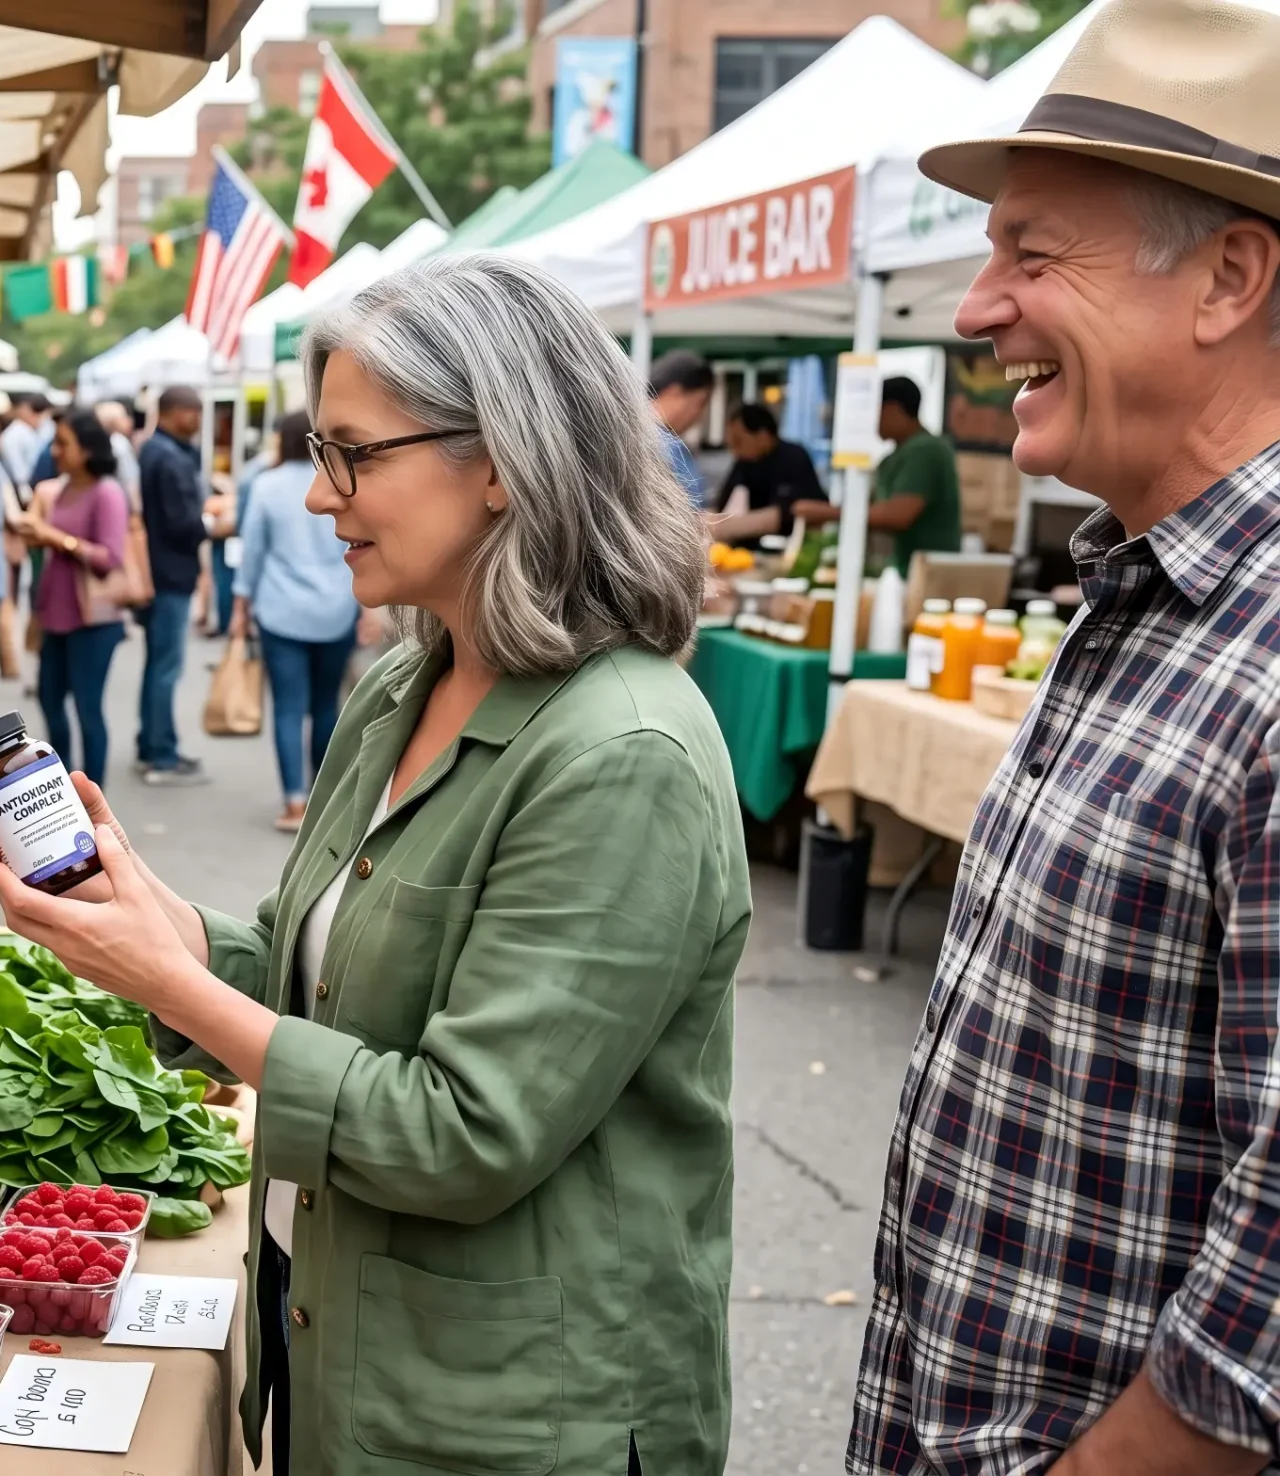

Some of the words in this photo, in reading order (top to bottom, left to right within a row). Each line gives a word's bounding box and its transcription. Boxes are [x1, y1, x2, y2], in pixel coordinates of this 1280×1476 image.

[680, 203, 758, 294] JUICE
[763, 184, 834, 279] BAR
[13, 790, 65, 822] COMPLEX
